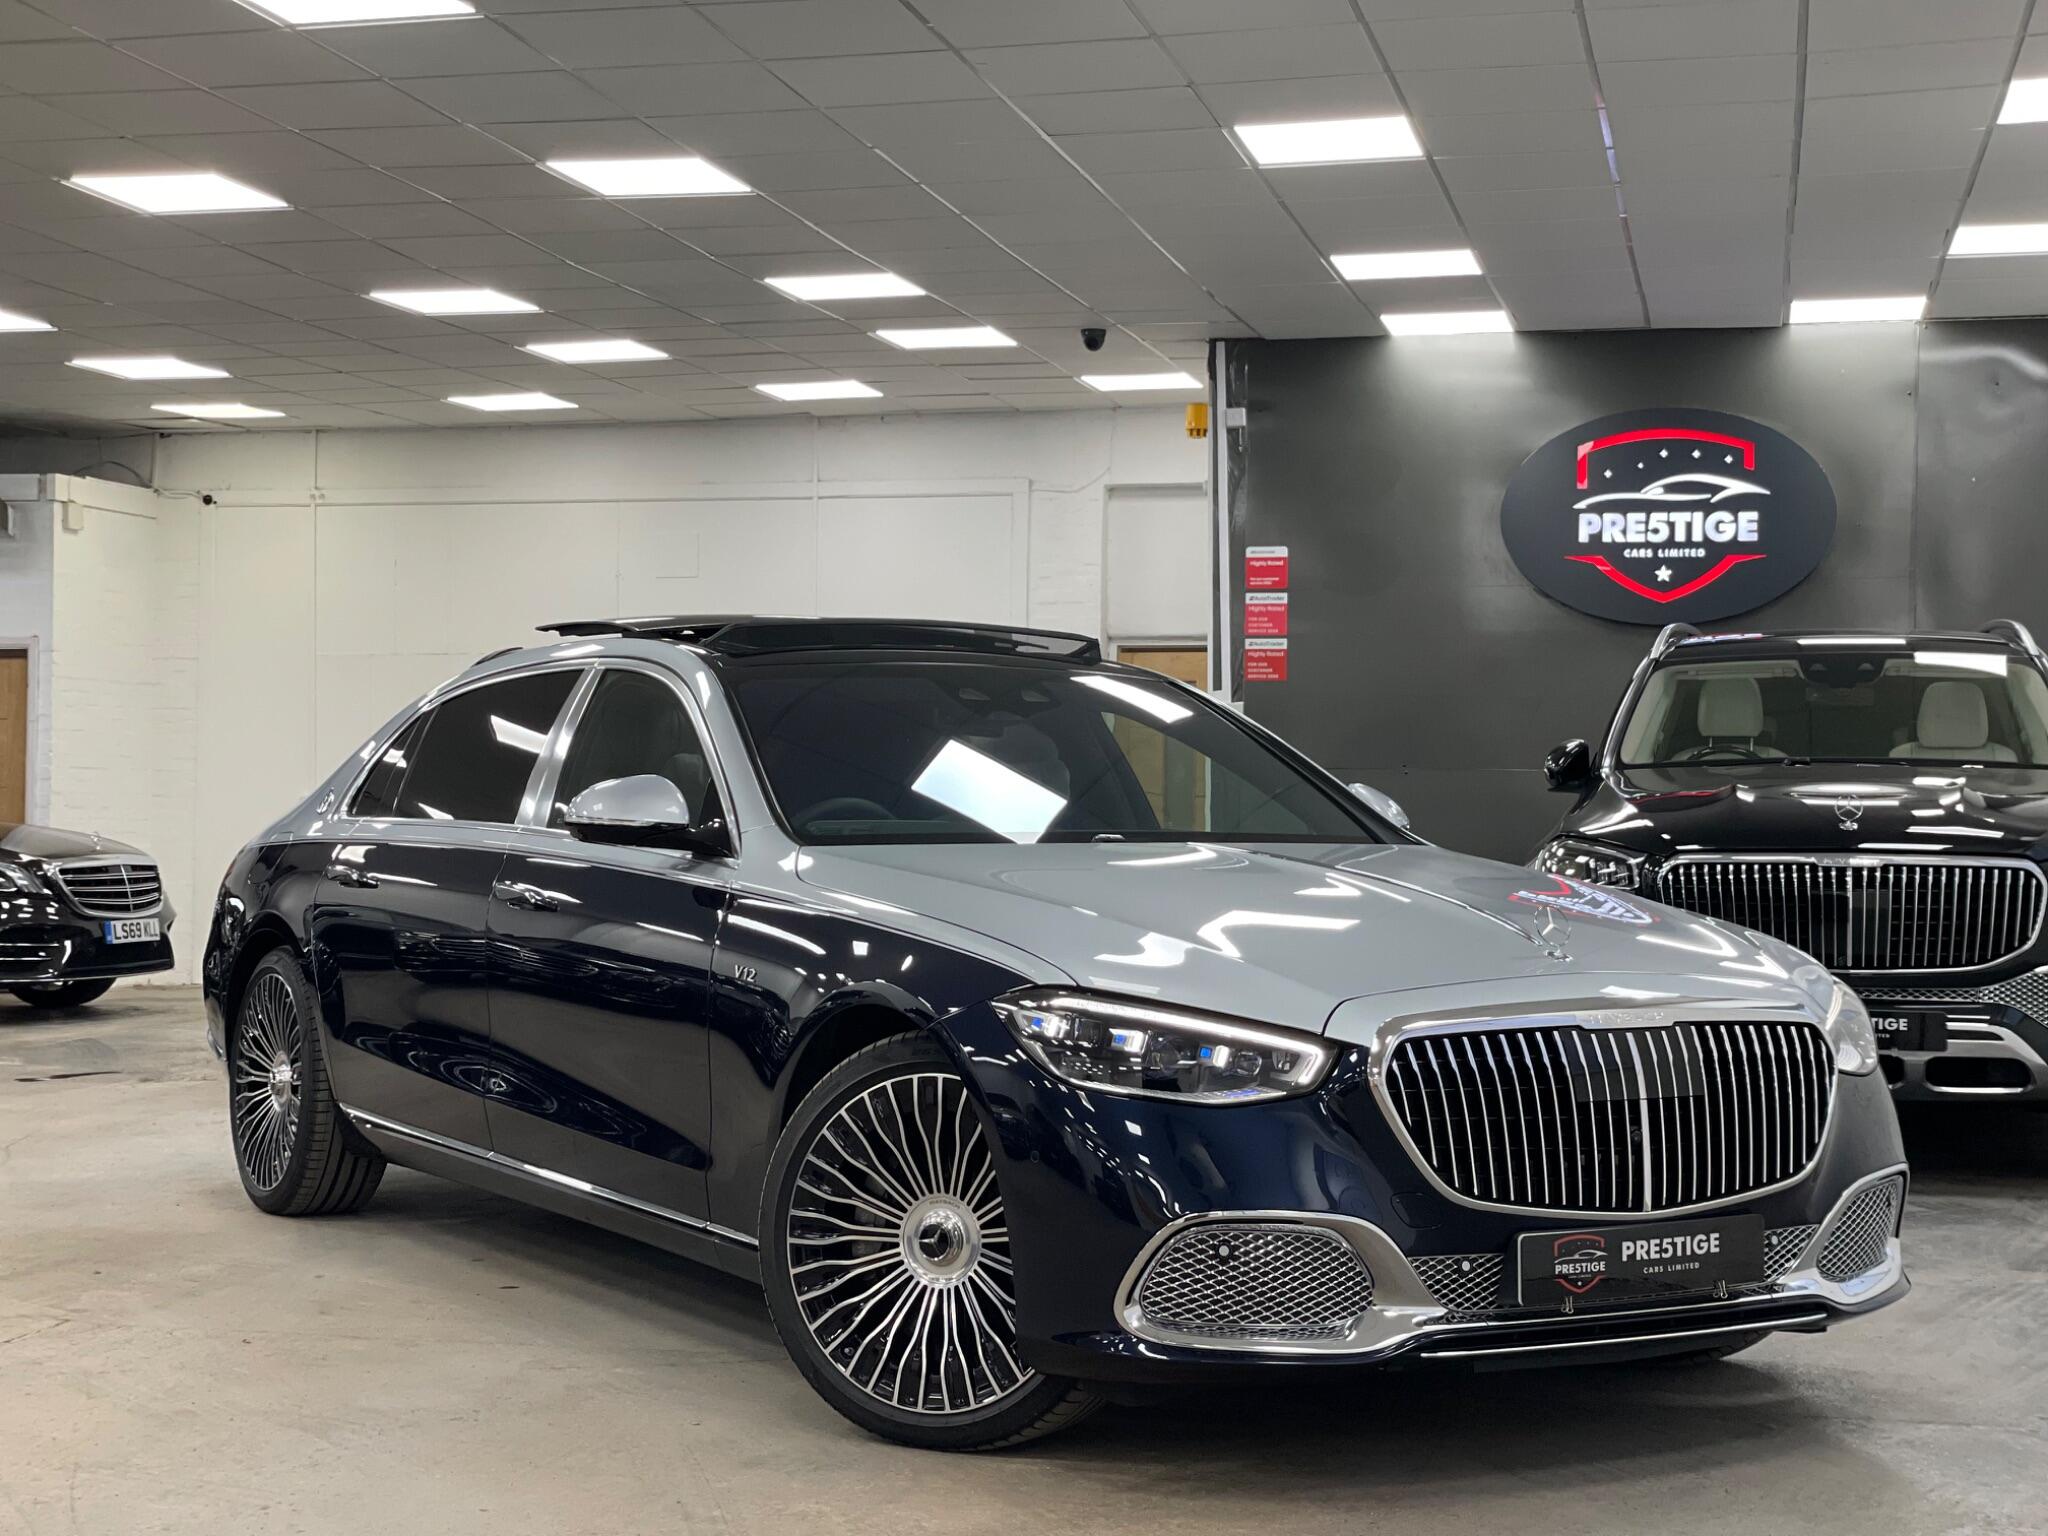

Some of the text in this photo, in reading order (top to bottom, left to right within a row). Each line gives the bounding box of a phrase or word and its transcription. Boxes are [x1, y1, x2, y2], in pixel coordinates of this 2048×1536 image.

[1623, 547, 1706, 559] CARS LIMITED
[113, 922, 142, 940] LS69
[734, 964, 757, 982] V12
[1871, 1017, 1909, 1031] TIGE
[1643, 1262, 1700, 1274] CARS LIMITED
